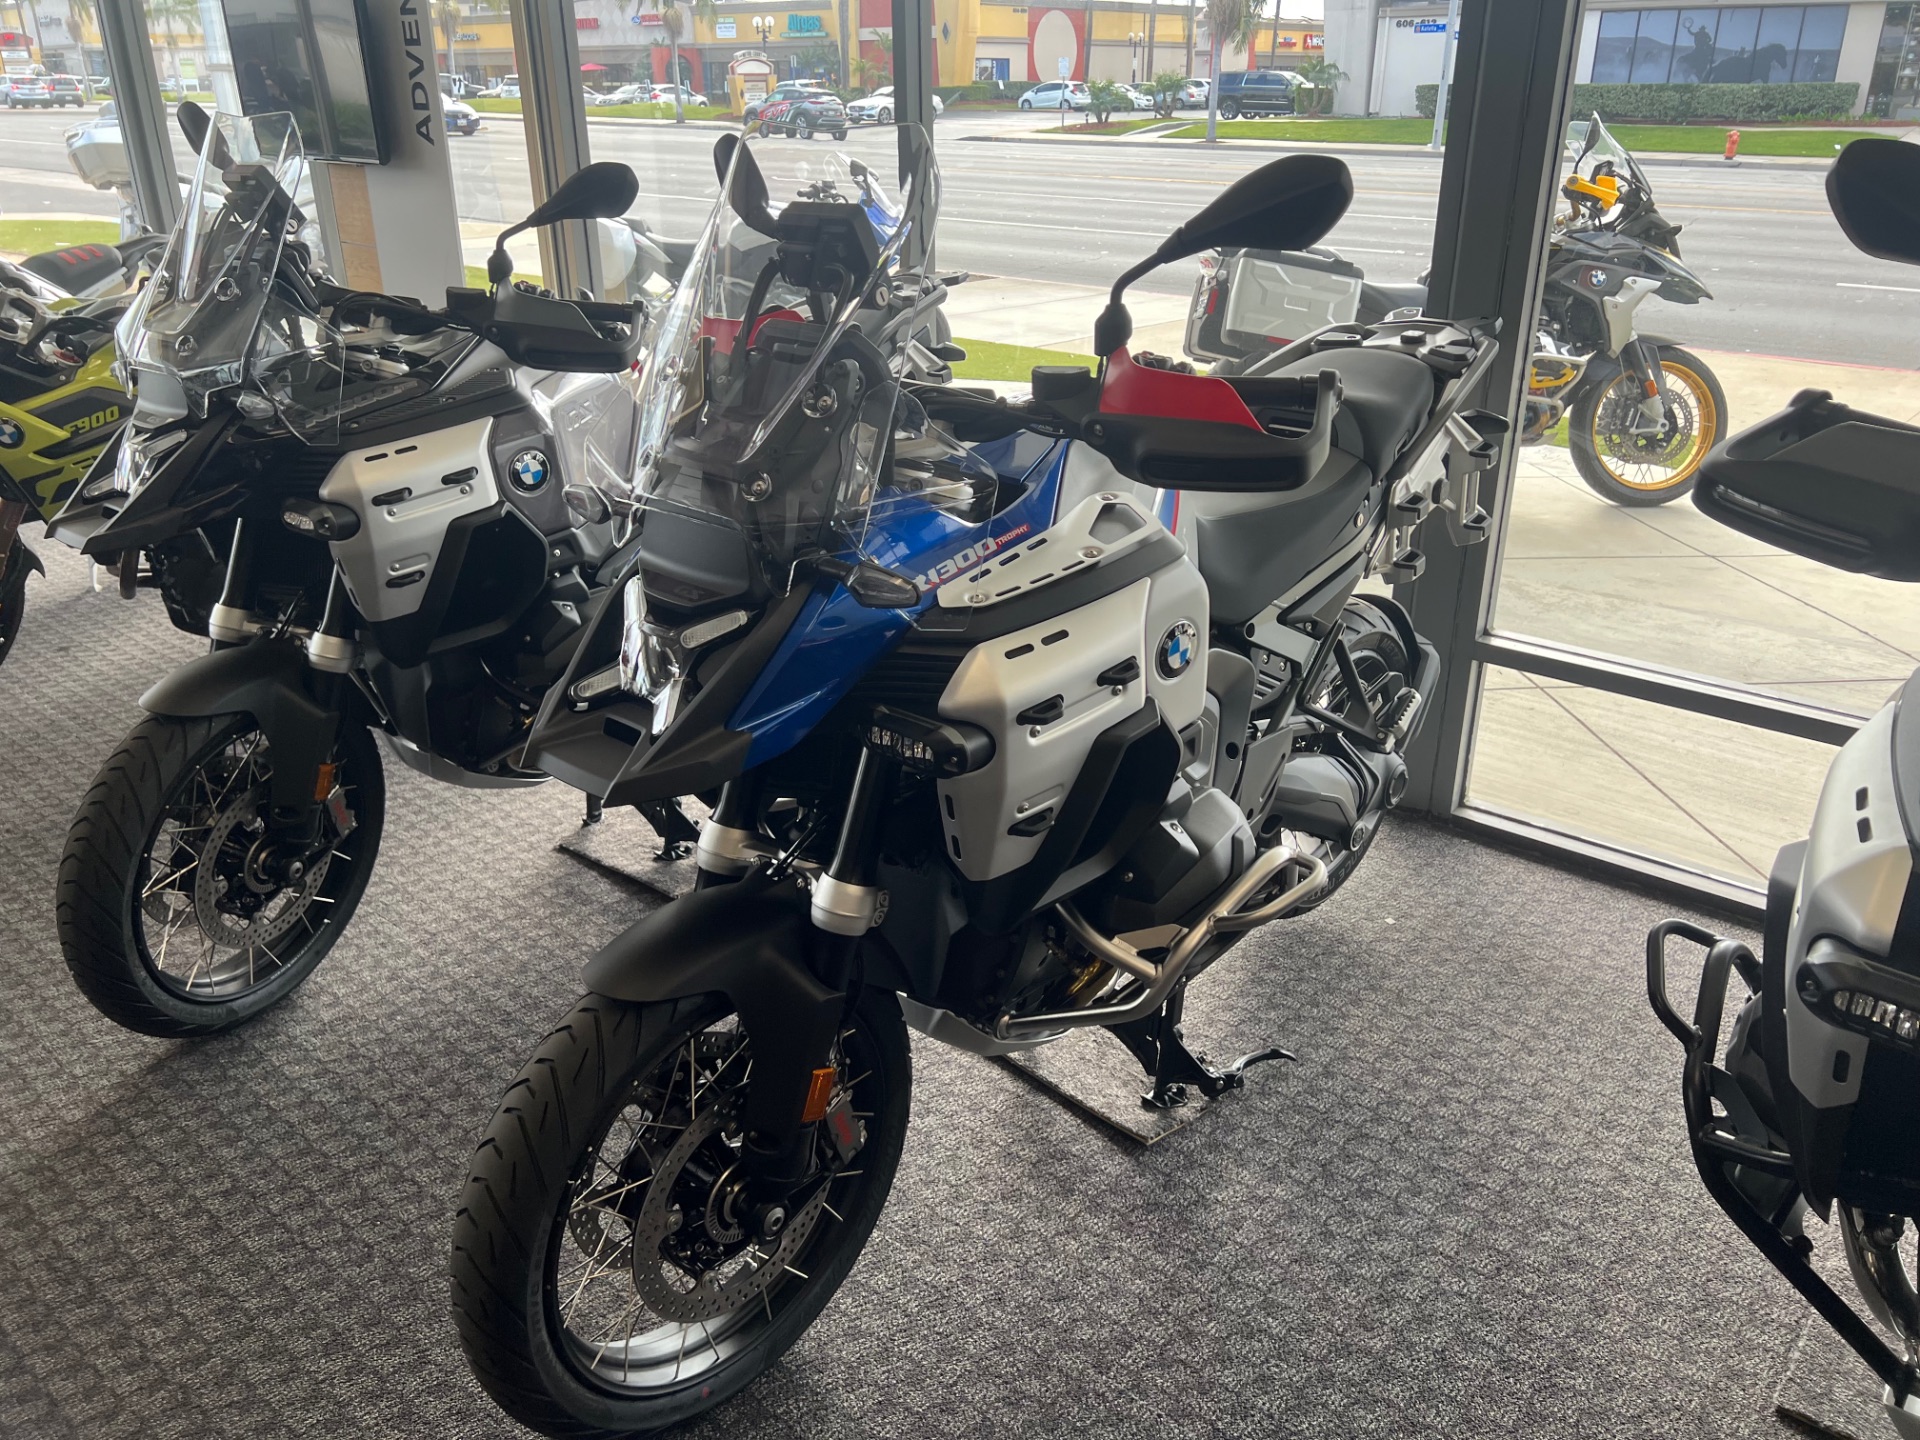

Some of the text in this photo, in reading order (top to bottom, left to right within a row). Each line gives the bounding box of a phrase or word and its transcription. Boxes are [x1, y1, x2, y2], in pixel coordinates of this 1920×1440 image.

[788, 14, 821, 32] Airgas
[63, 405, 119, 433] F900
[513, 453, 544, 470] BMW
[995, 524, 1029, 546] TROPHY
[1163, 623, 1195, 650] BMW
